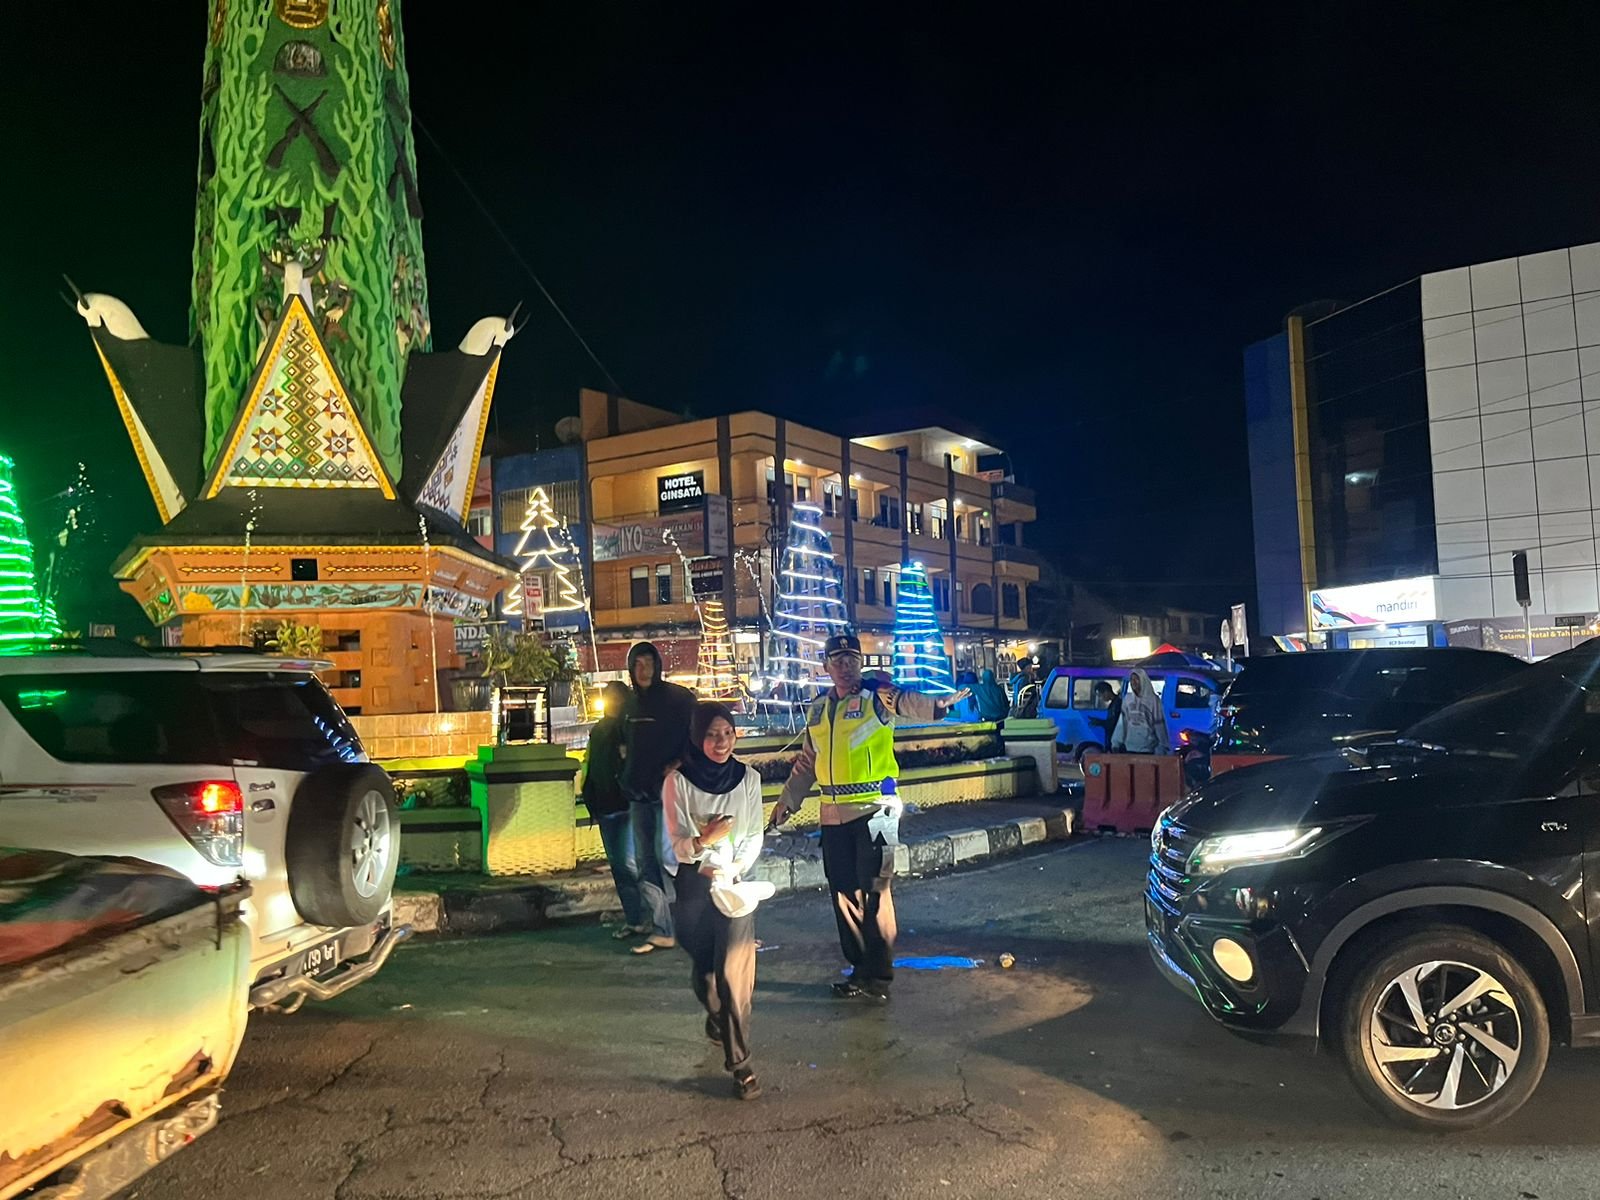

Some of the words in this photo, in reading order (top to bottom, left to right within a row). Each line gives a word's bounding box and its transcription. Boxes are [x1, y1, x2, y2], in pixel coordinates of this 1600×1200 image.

[665, 476, 697, 489] HOTEL
[660, 486, 702, 501] GINSATA
[1376, 600, 1418, 613] mandiri
[1499, 632, 1528, 640] Selama
